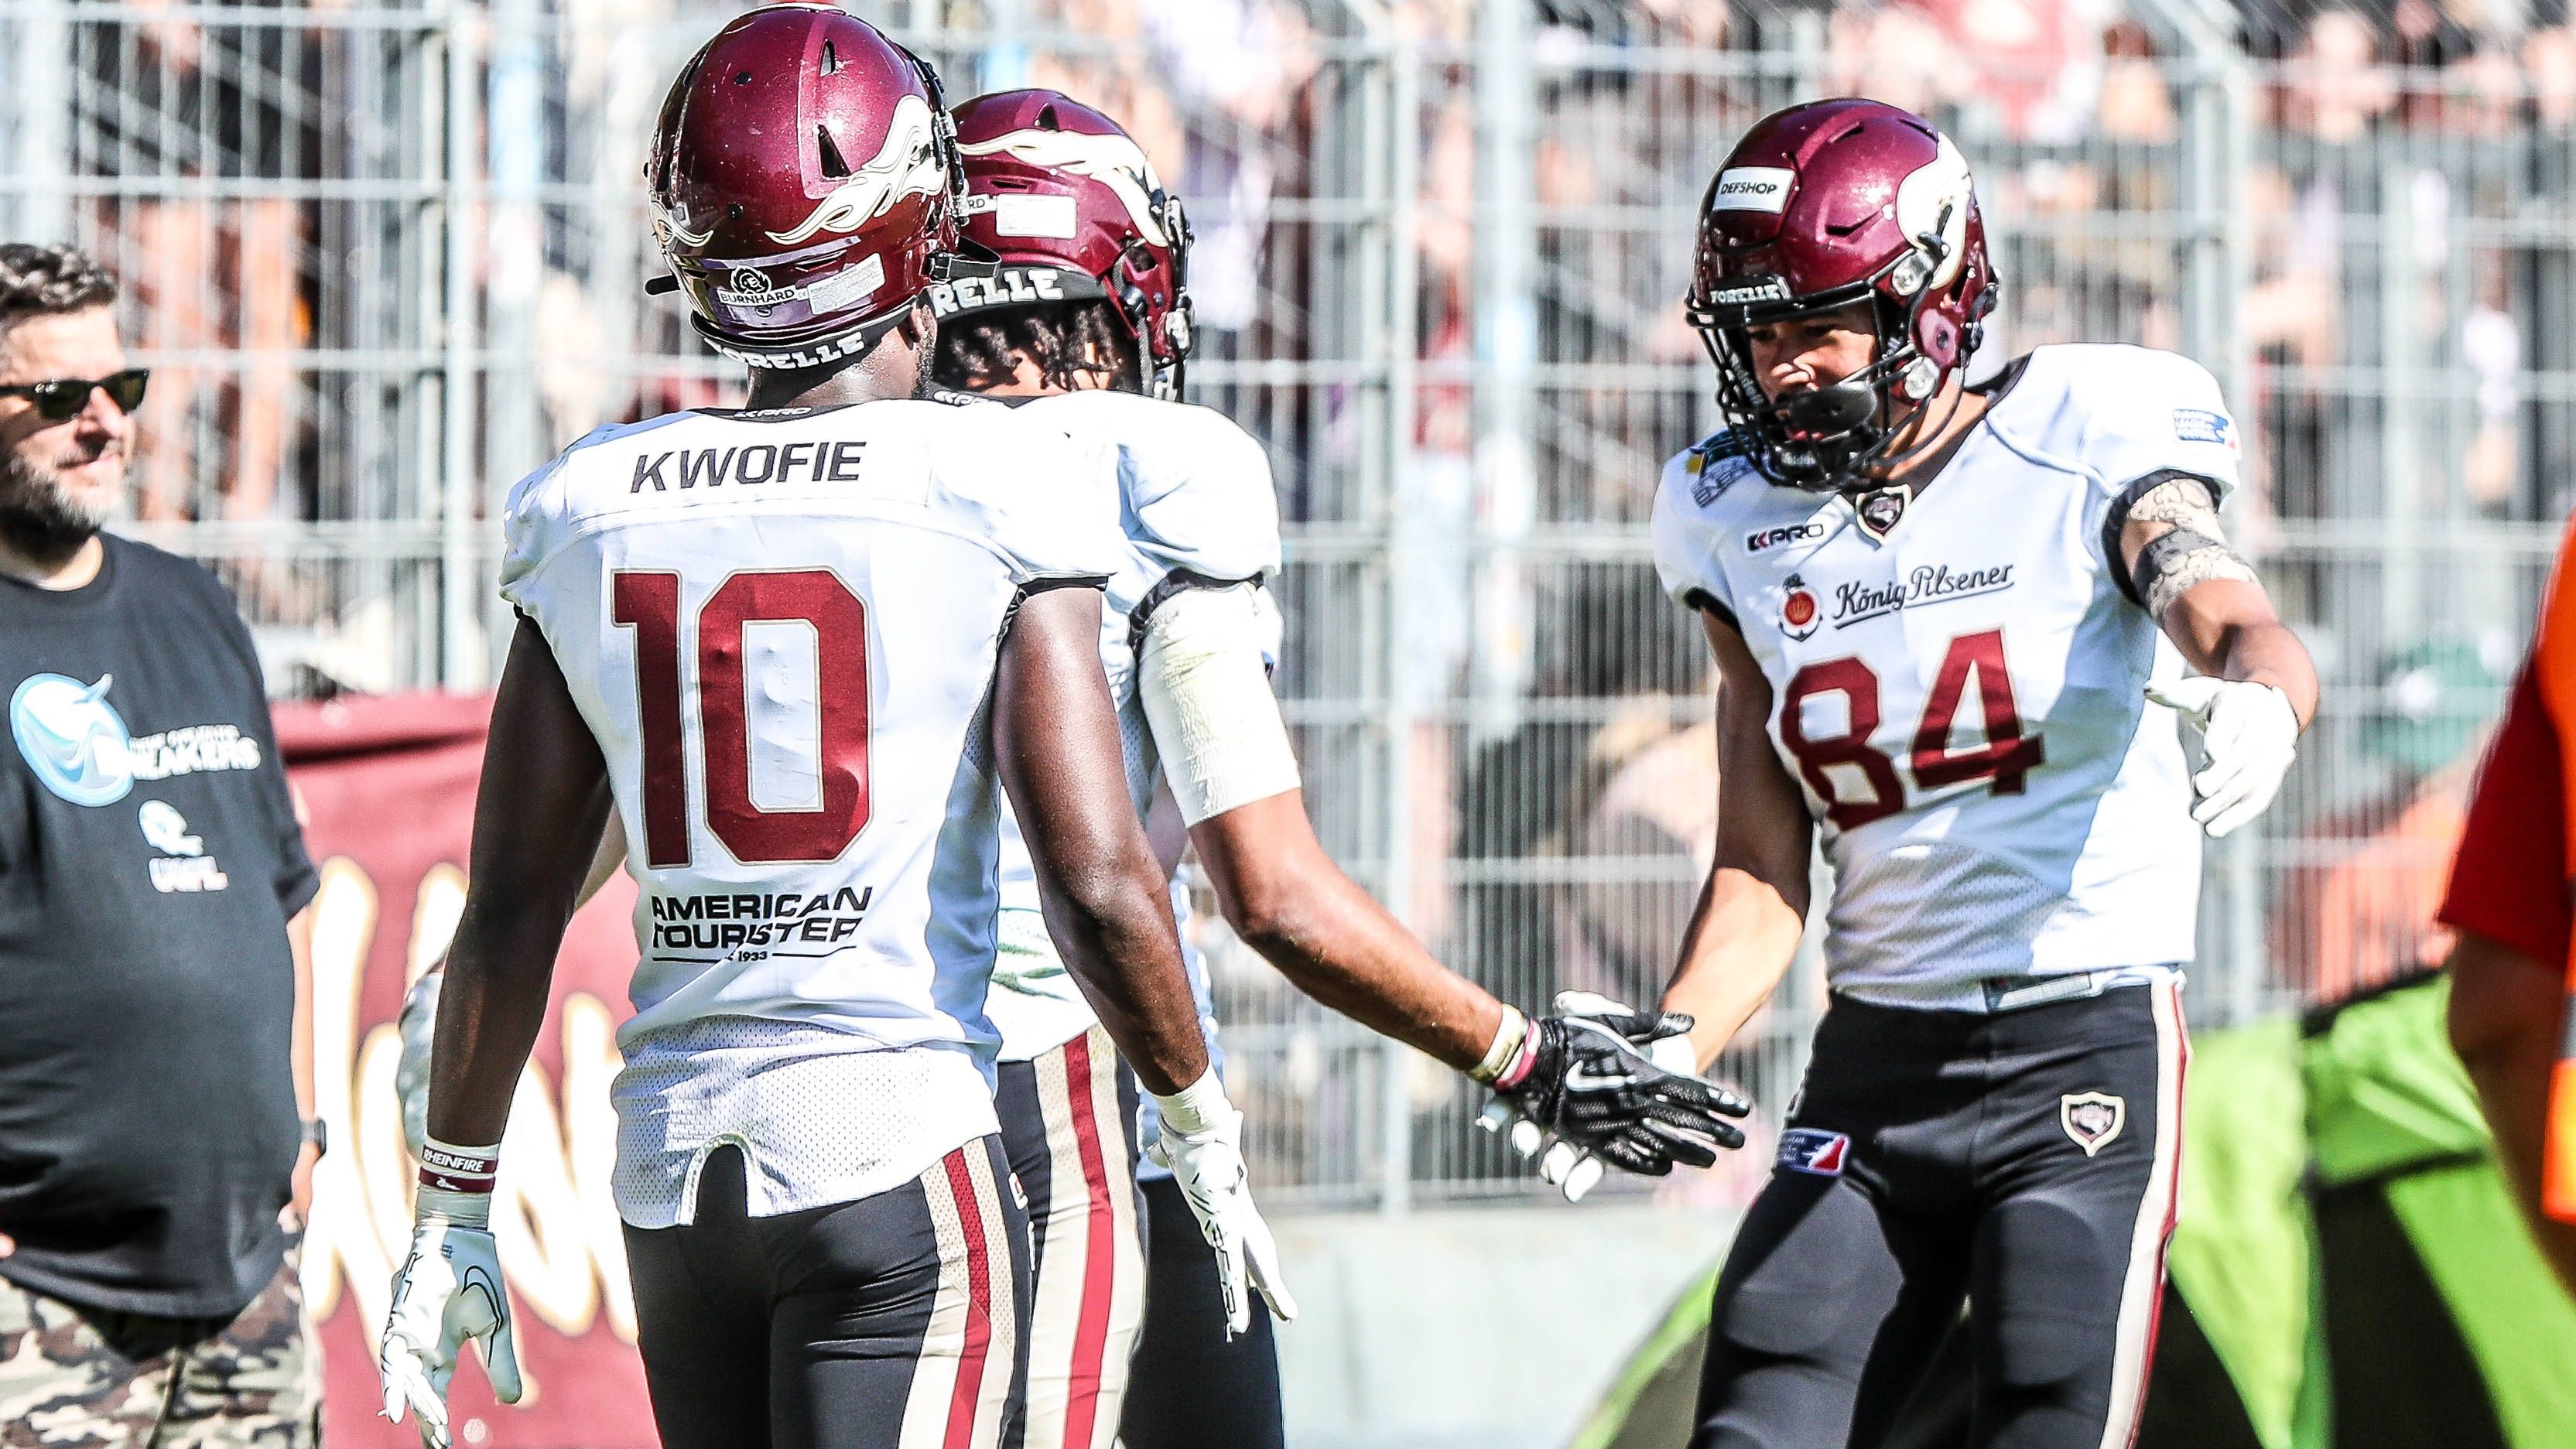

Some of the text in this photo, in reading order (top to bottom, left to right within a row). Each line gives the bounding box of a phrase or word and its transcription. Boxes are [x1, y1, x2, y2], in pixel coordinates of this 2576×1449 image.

[1720, 182, 1778, 195] DEFSHOP
[720, 289, 795, 305] BURNHARD
[932, 269, 1065, 318] RELLE
[630, 441, 867, 494] KWOFIE
[1833, 564, 2015, 620] König Pilsener
[611, 566, 874, 870] 10
[1780, 624, 2046, 832] 84
[651, 887, 873, 921] AMERICAN
[737, 950, 768, 962] 1933
[423, 1149, 484, 1172] RHEINFIRE
